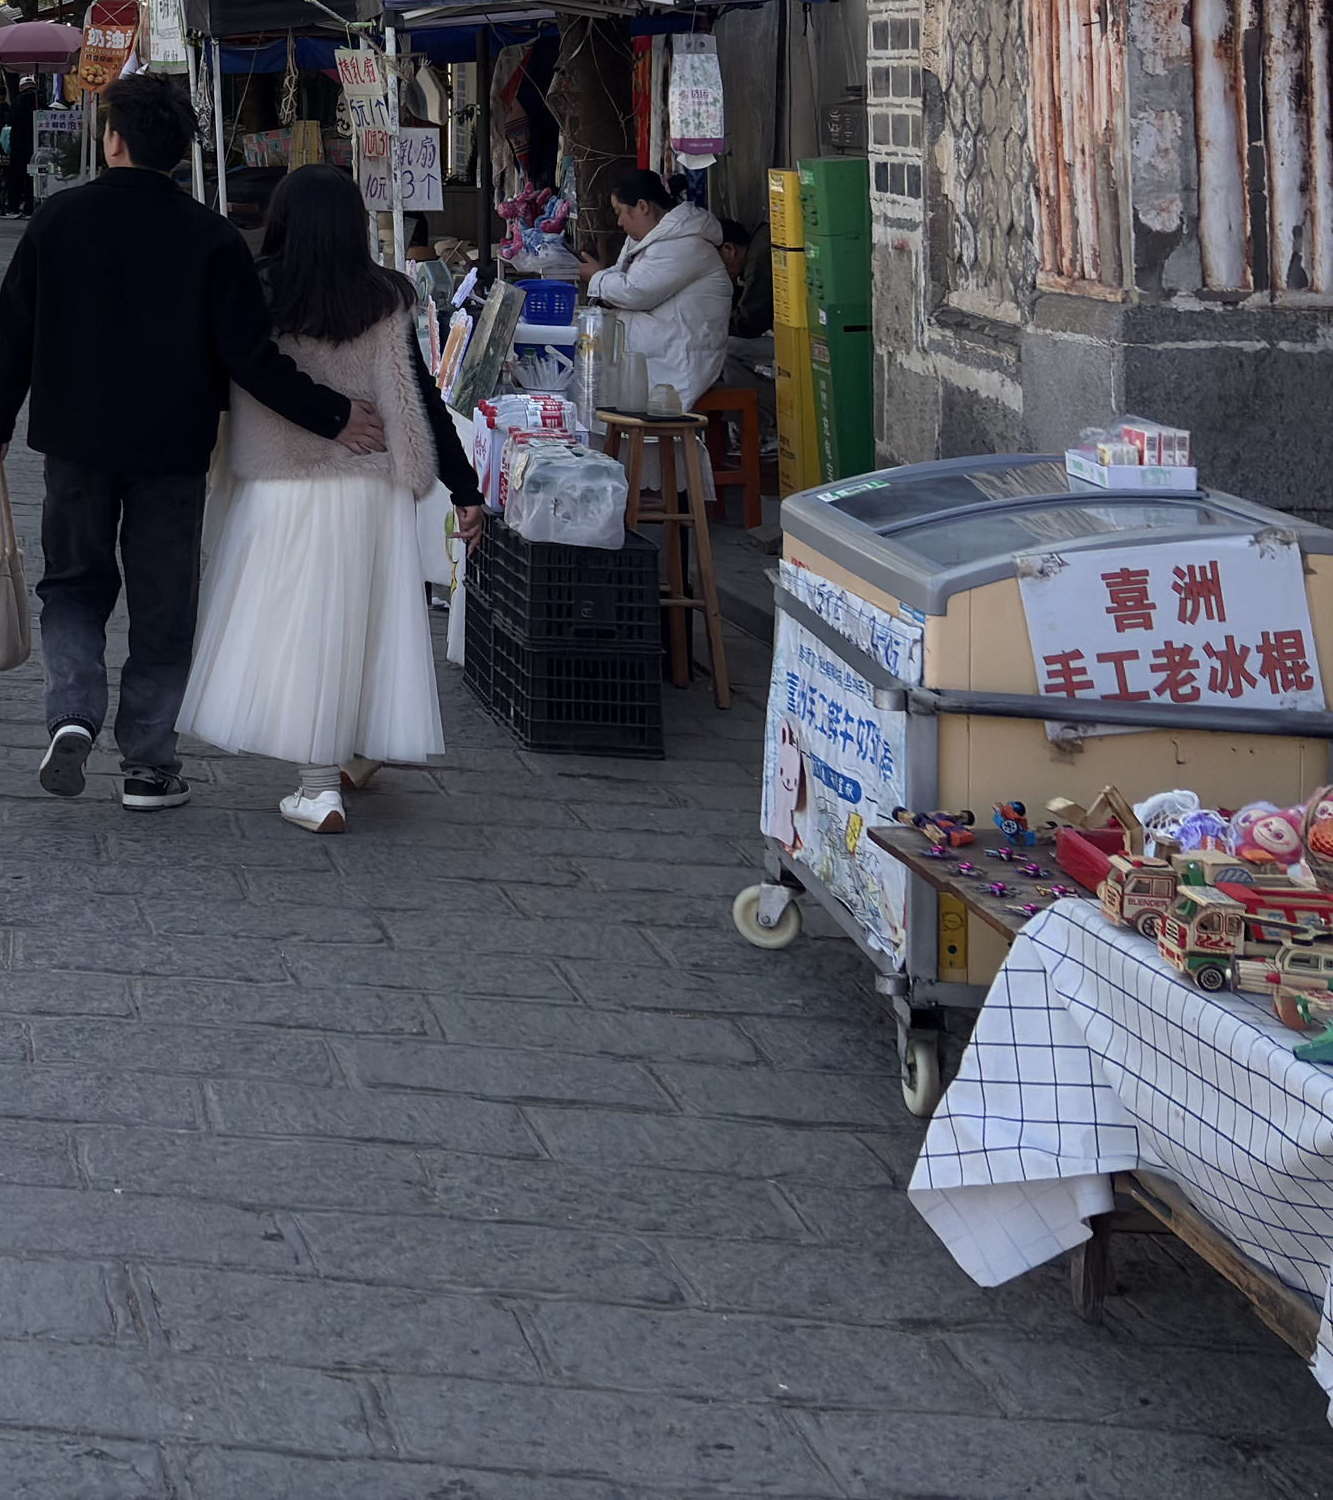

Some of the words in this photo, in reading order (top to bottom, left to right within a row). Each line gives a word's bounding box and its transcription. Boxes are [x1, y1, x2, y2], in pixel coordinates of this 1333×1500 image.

[338, 57, 378, 85] 烤乳扇
[1101, 560, 1226, 633] 喜洲
[1043, 629, 1315, 704] 手工老冰棍
